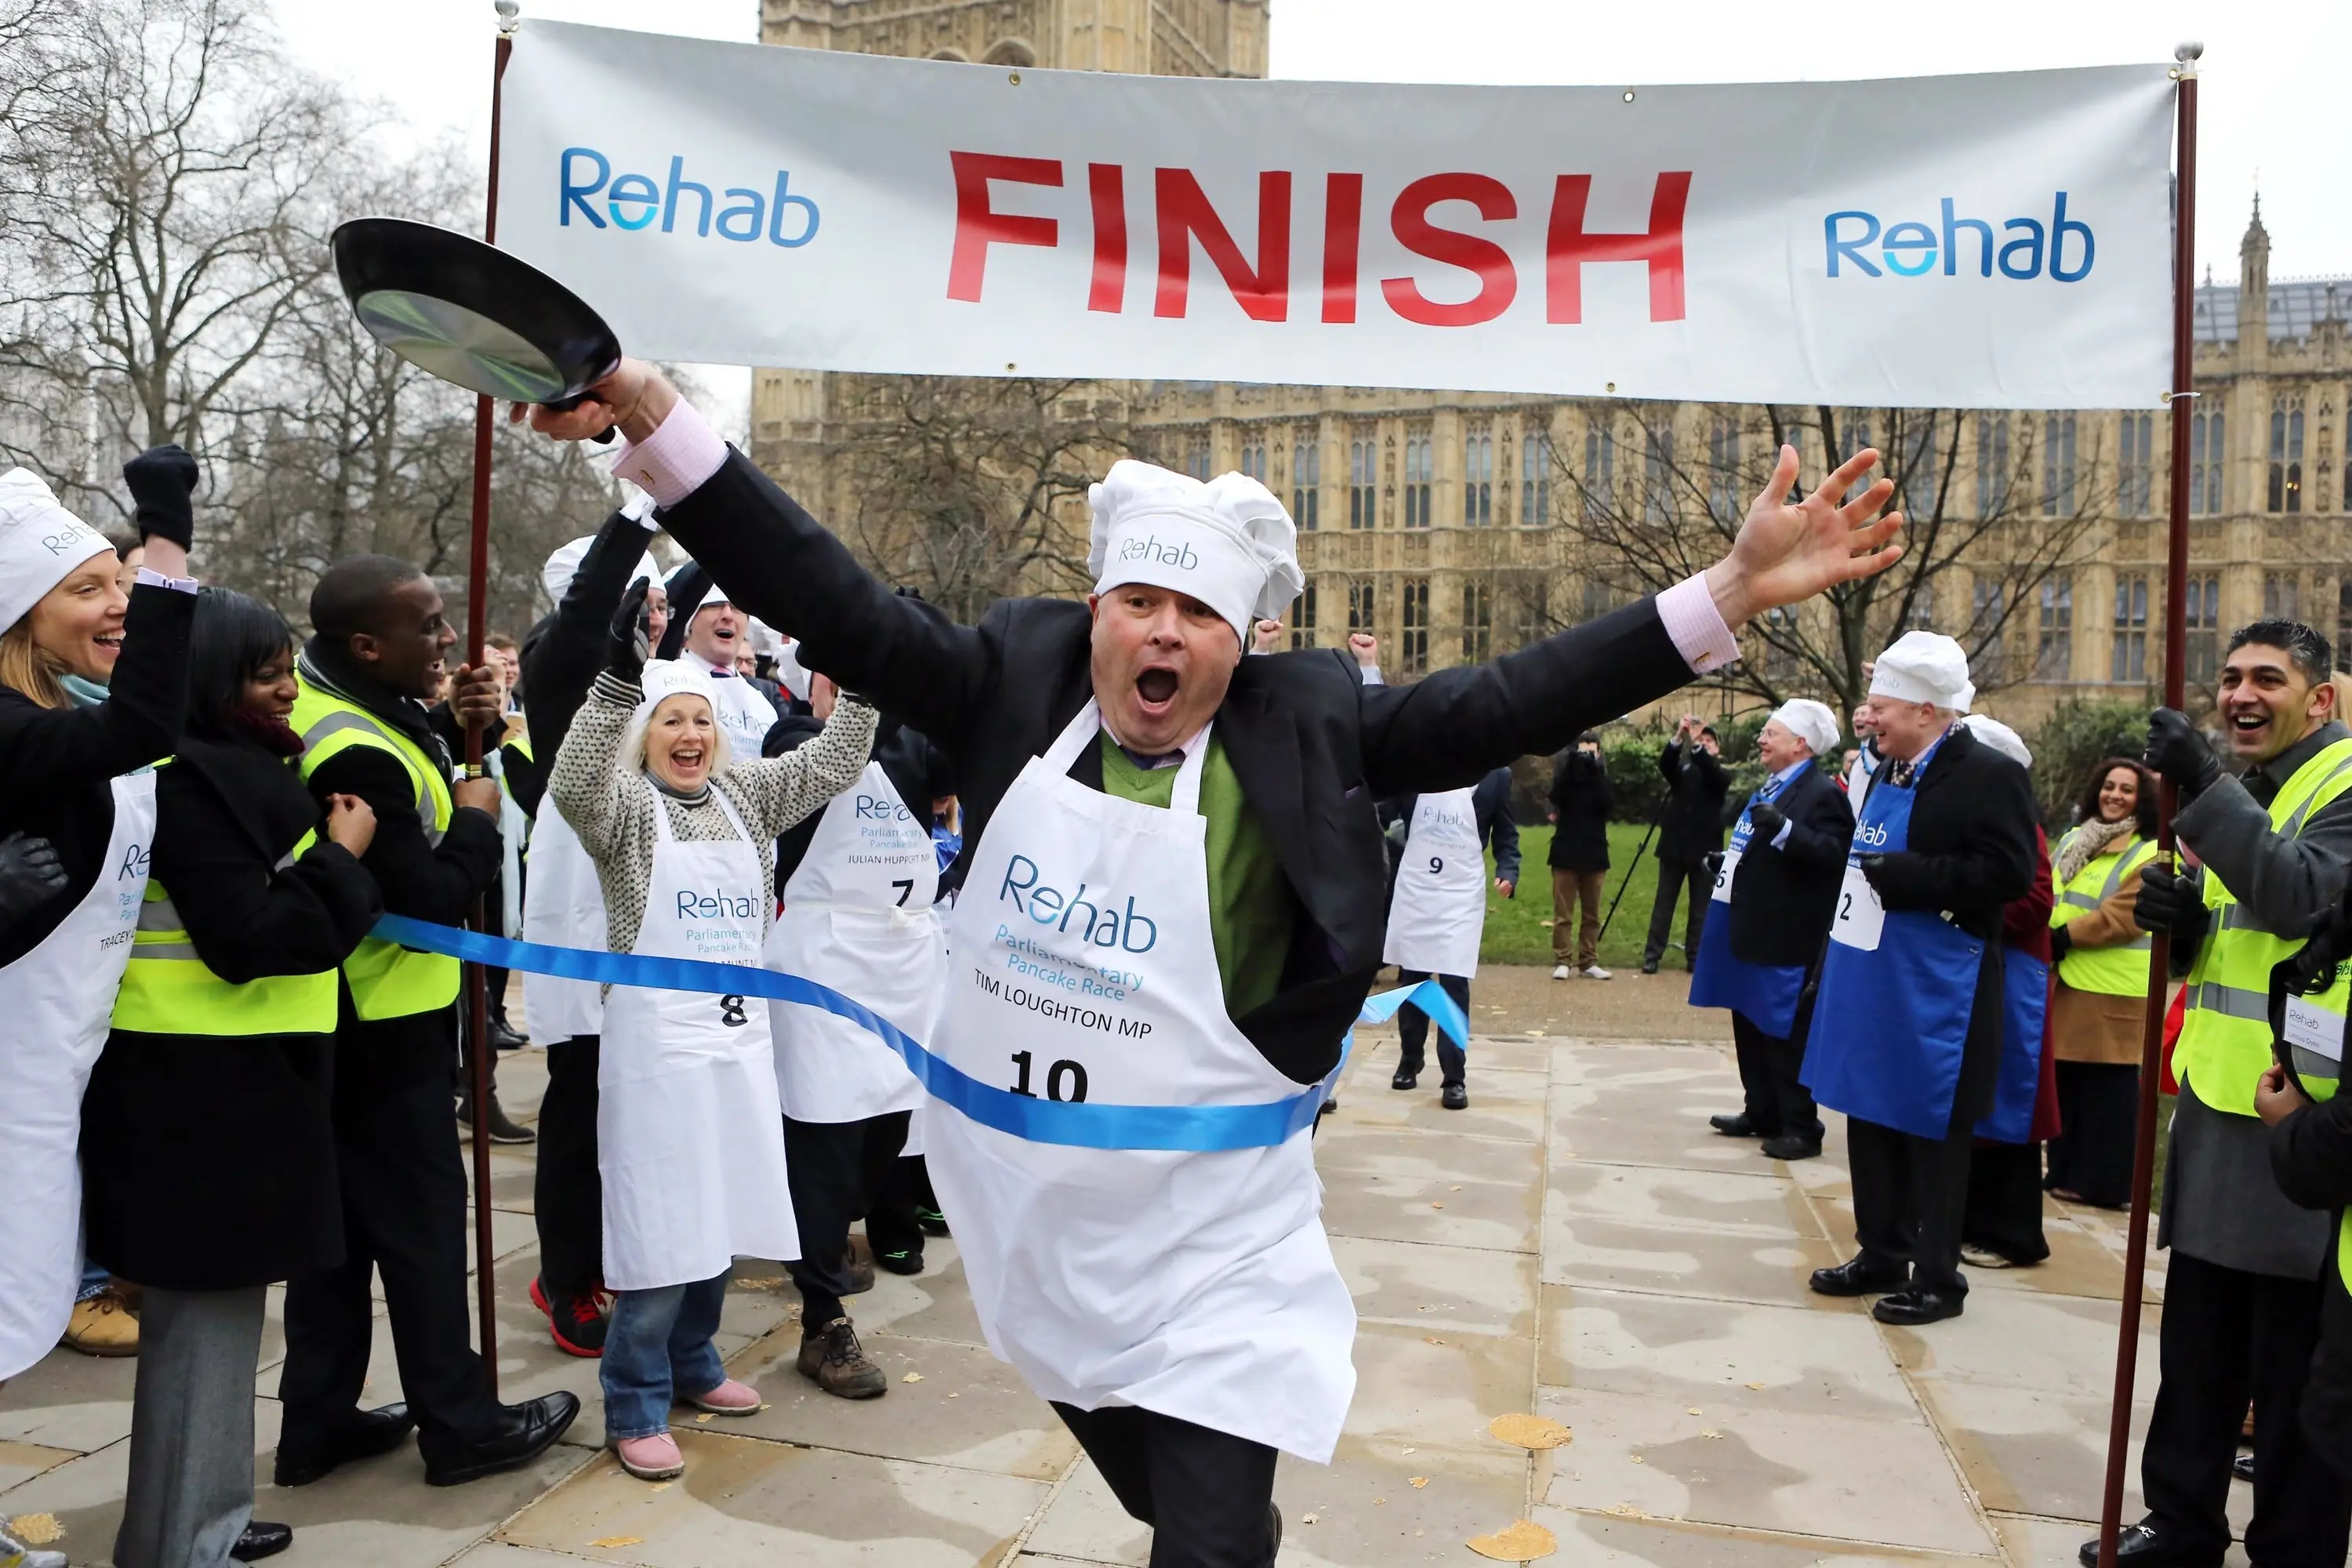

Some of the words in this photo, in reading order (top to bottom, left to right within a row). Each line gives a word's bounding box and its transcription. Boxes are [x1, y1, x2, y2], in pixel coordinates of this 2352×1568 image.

[560, 147, 820, 248] Rehab
[946, 151, 1693, 325] FINISH
[1824, 191, 2095, 282] Rehab
[42, 523, 96, 556] Reha
[1119, 535, 1198, 571] Rehab
[1423, 806, 1464, 826] Rhab
[848, 855, 882, 864] JULIAN
[1429, 857, 1443, 874] 9
[892, 879, 914, 907] 7
[1717, 870, 1727, 888] 6
[677, 887, 759, 919] Rehab
[1000, 855, 1157, 953] Rehab
[1840, 893, 1853, 921] 2
[100, 930, 130, 952] TRACEY
[698, 942, 737, 953] Pancake
[1007, 953, 1076, 990] Pancake
[1081, 978, 1125, 1001] Race
[720, 994, 748, 1027] 8
[975, 968, 1000, 996] TIM
[1004, 985, 1112, 1032] LOUGHTON
[1118, 1018, 1152, 1040] MP
[2288, 1009, 2319, 1029] Rehab
[1010, 1050, 1088, 1104] 10
